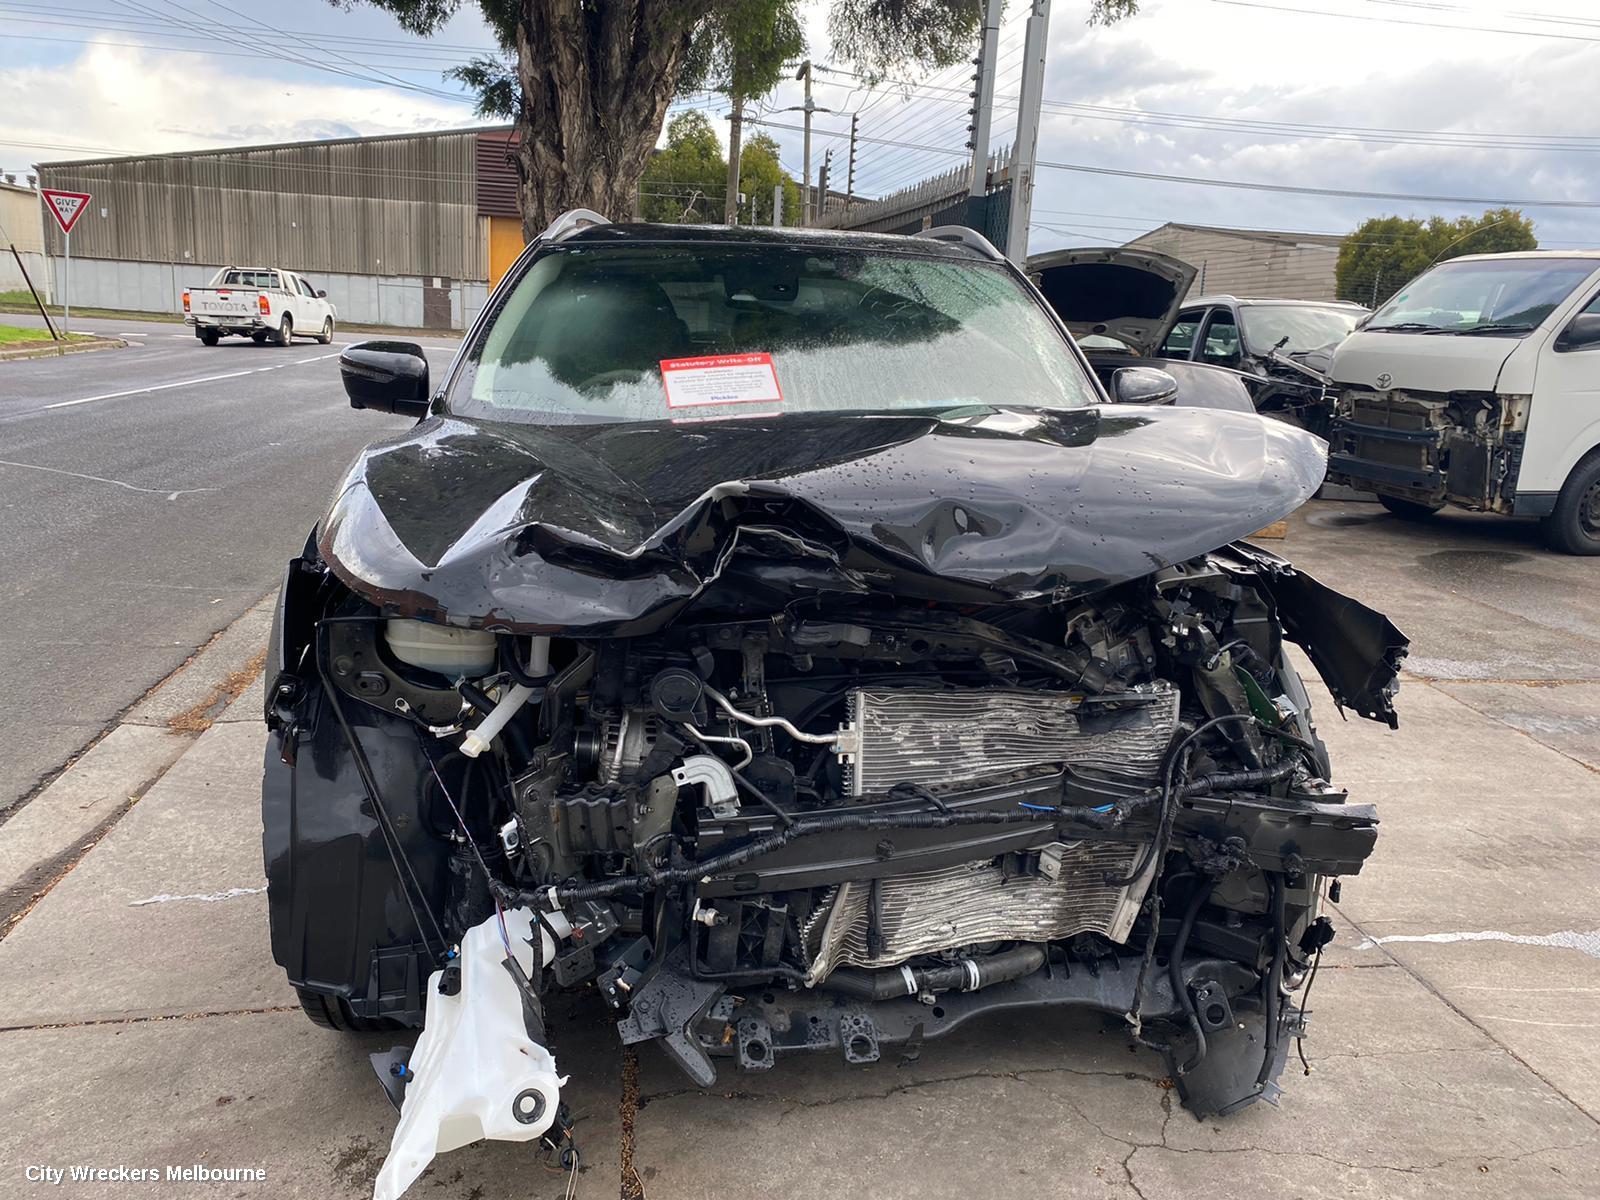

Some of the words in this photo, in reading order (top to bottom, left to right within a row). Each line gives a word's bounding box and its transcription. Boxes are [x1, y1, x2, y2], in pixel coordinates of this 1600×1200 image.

[56, 198, 77, 207] GIVE
[201, 302, 248, 312] TOYOTA
[670, 360, 714, 369] Statutory
[717, 357, 762, 366] Write-Off
